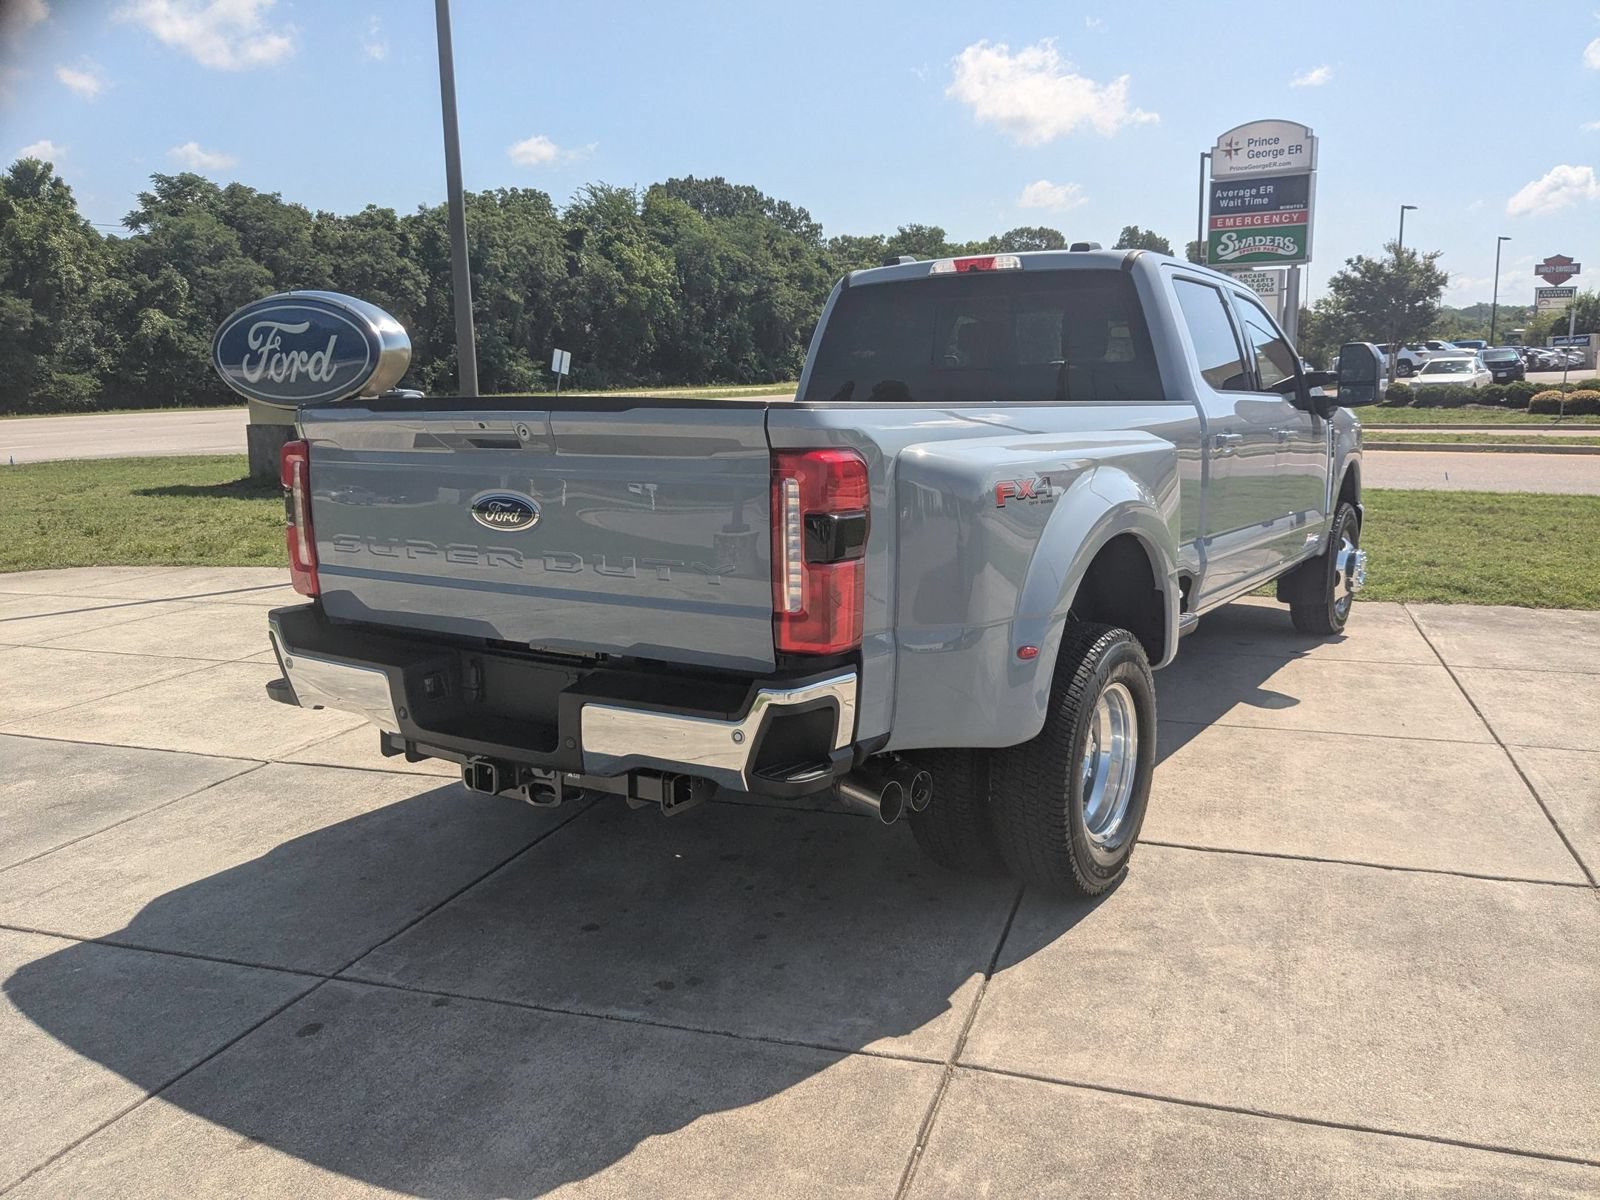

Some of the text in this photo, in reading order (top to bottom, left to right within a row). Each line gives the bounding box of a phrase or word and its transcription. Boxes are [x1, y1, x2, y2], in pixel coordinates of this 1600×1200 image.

[1247, 137, 1280, 147] Prince
[1247, 144, 1303, 159] George ER
[1229, 161, 1292, 171] PrinceGeorgeER.com
[1216, 185, 1274, 198] Average ER
[1220, 197, 1269, 207] Wait Time
[1217, 213, 1299, 227] EMERGENCY
[242, 321, 338, 384] Ford
[994, 476, 1053, 508] FX4
[485, 501, 521, 523] Ford
[332, 533, 736, 585] SUPER DUTY
